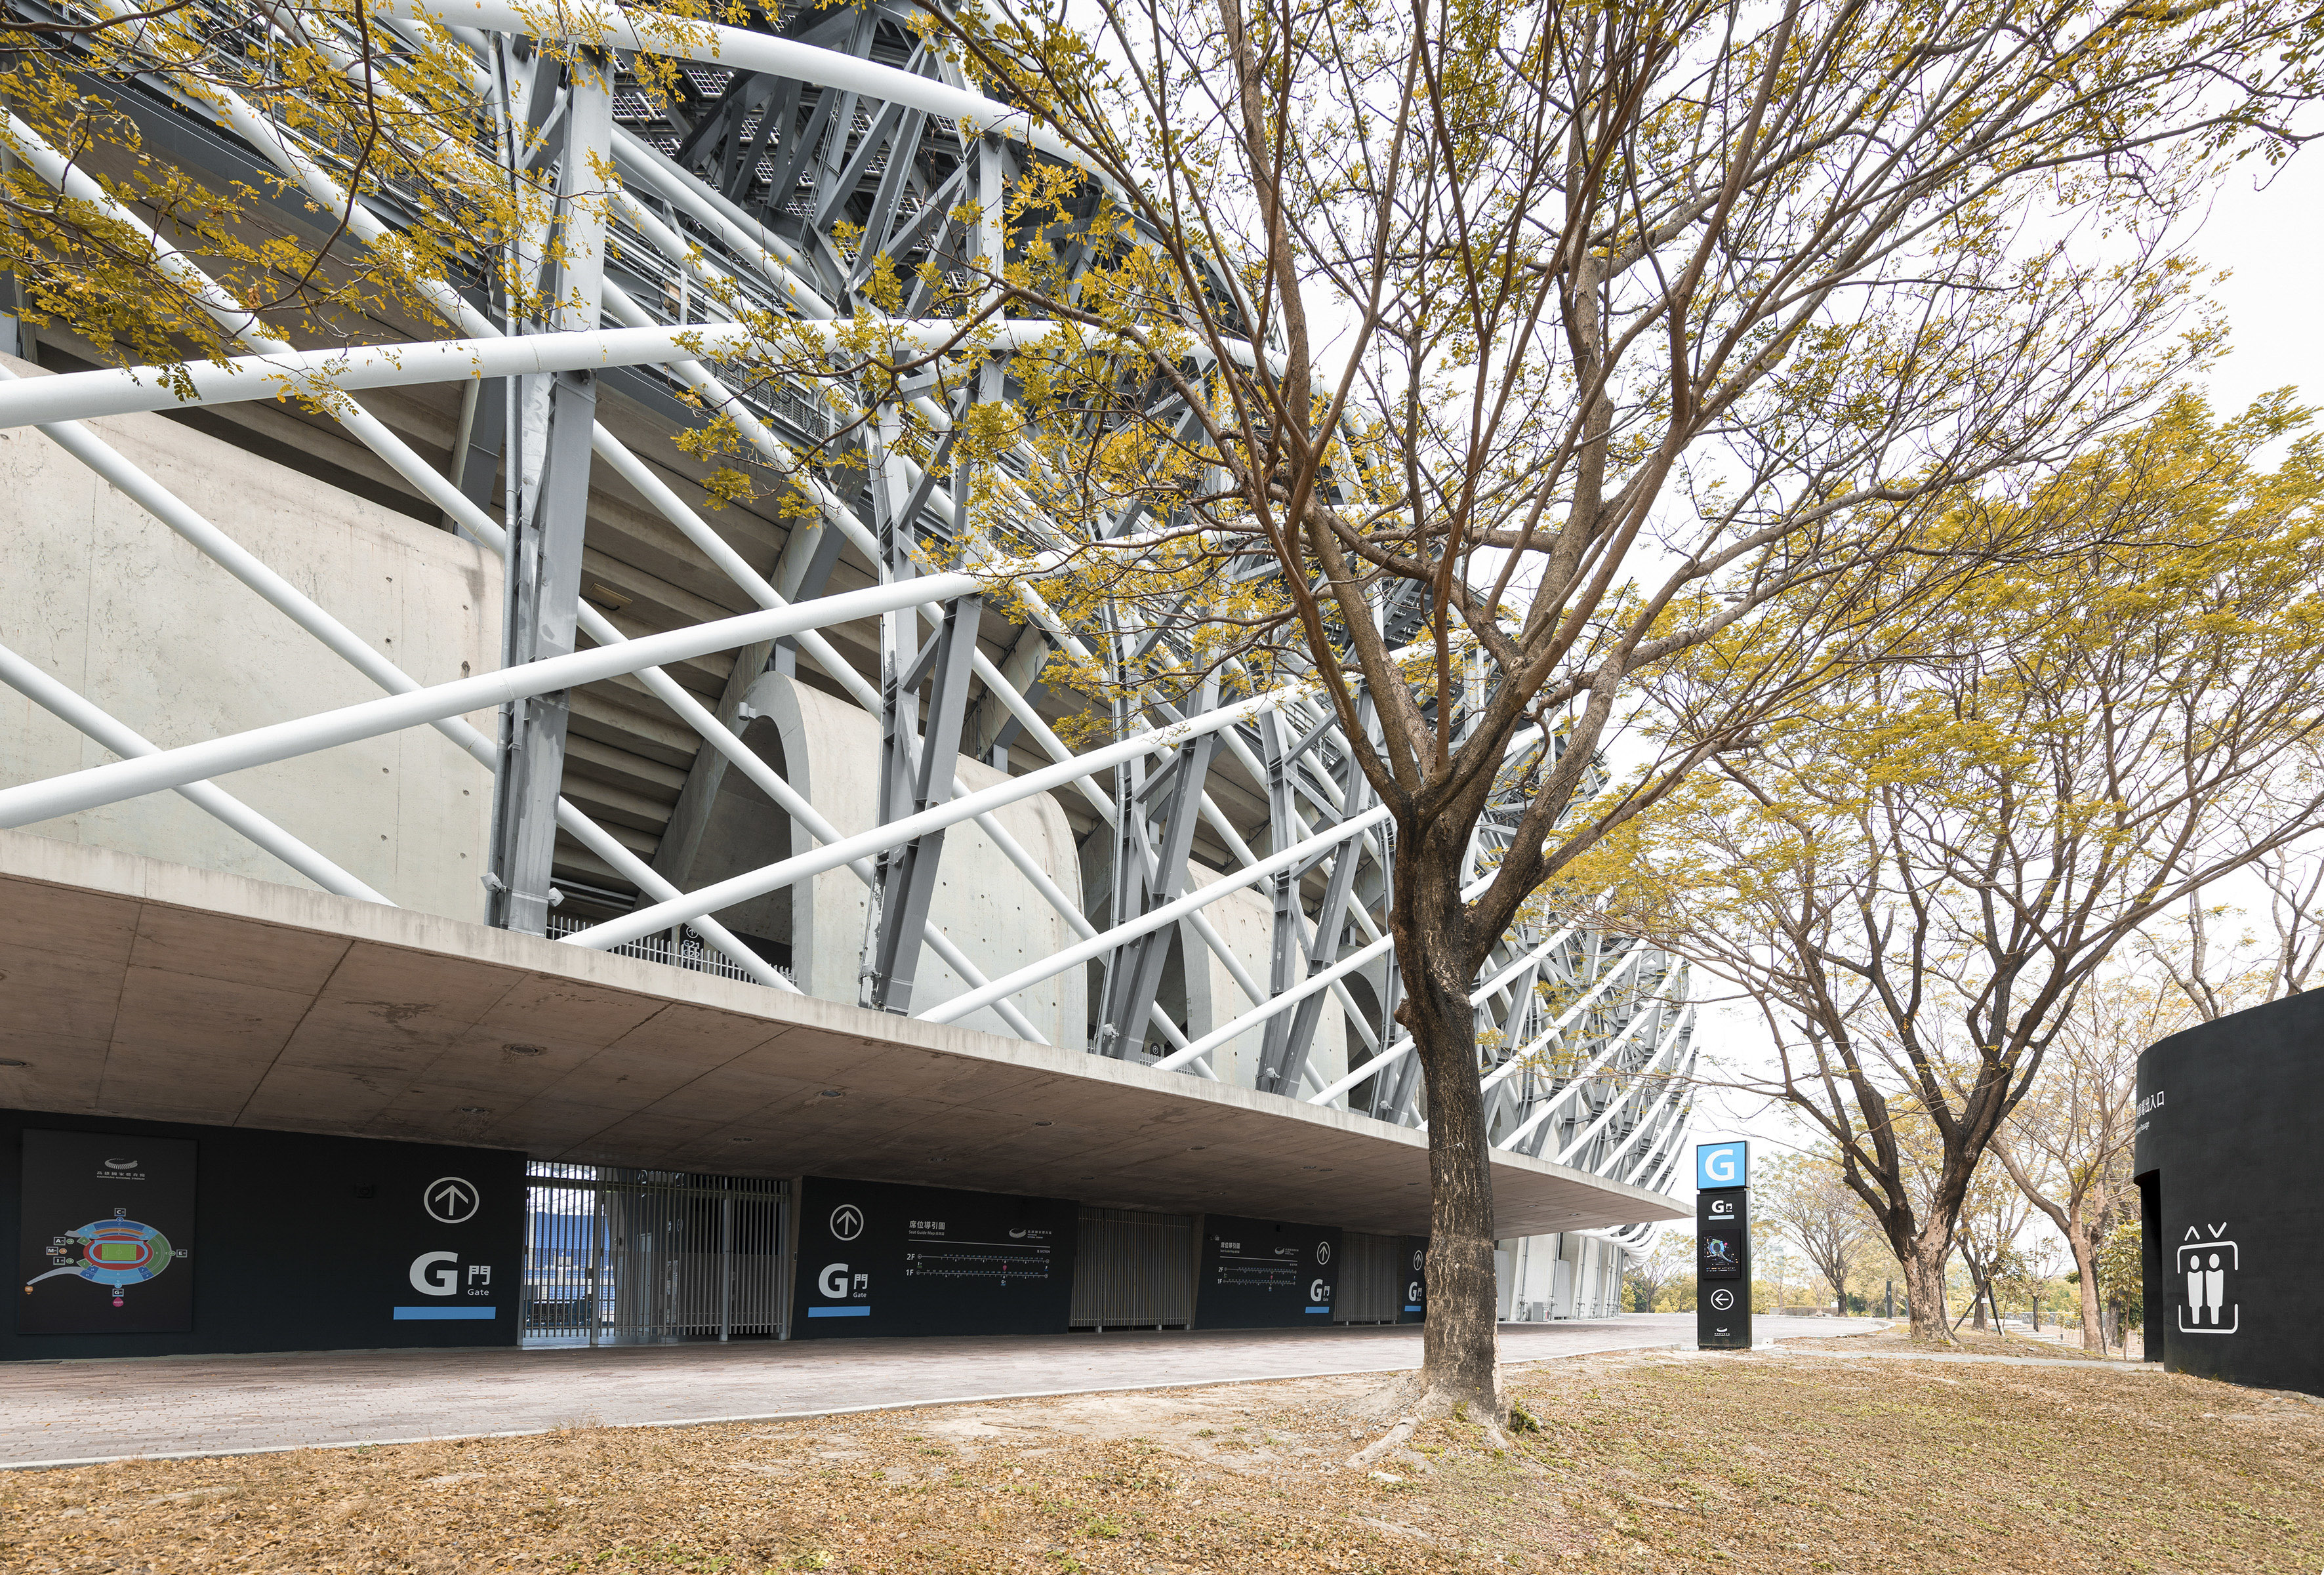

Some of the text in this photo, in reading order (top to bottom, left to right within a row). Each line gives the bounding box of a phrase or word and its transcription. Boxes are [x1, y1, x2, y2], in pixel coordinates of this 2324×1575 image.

[683, 939, 700, 949] G21
[683, 949, 700, 959] G22
[1705, 1149, 1734, 1181] G
[1711, 1200, 1724, 1213] G
[409, 1251, 491, 1296] G 門
[819, 1263, 868, 1298] G 門
[1310, 1278, 1330, 1301] G 門
[1408, 1281, 1417, 1301] G
